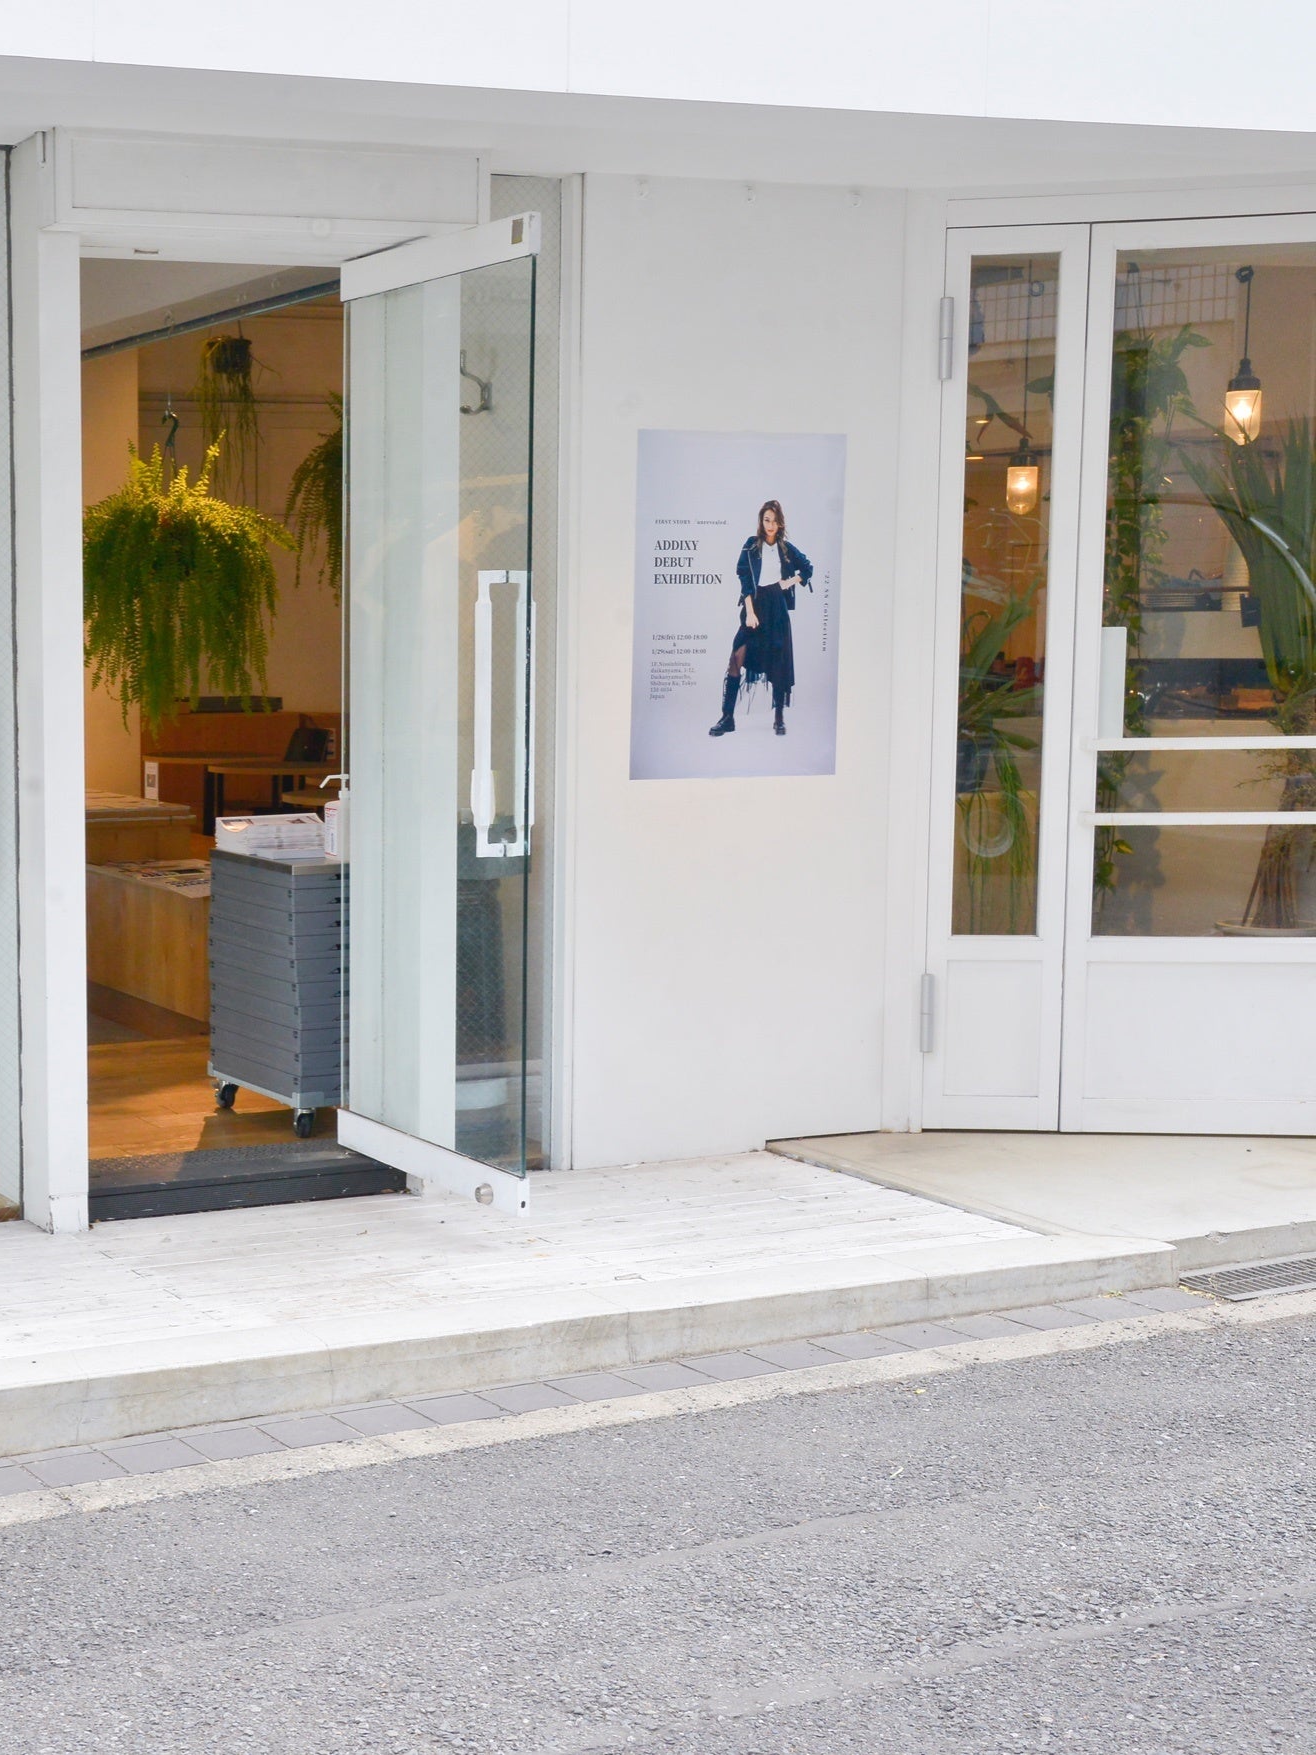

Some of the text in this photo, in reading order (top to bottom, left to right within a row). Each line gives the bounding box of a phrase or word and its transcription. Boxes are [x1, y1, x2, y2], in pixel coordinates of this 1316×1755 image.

[654, 540, 699, 551] ADDIXY
[654, 557, 694, 568] DEBUT
[653, 574, 722, 585] EXHIBITION
